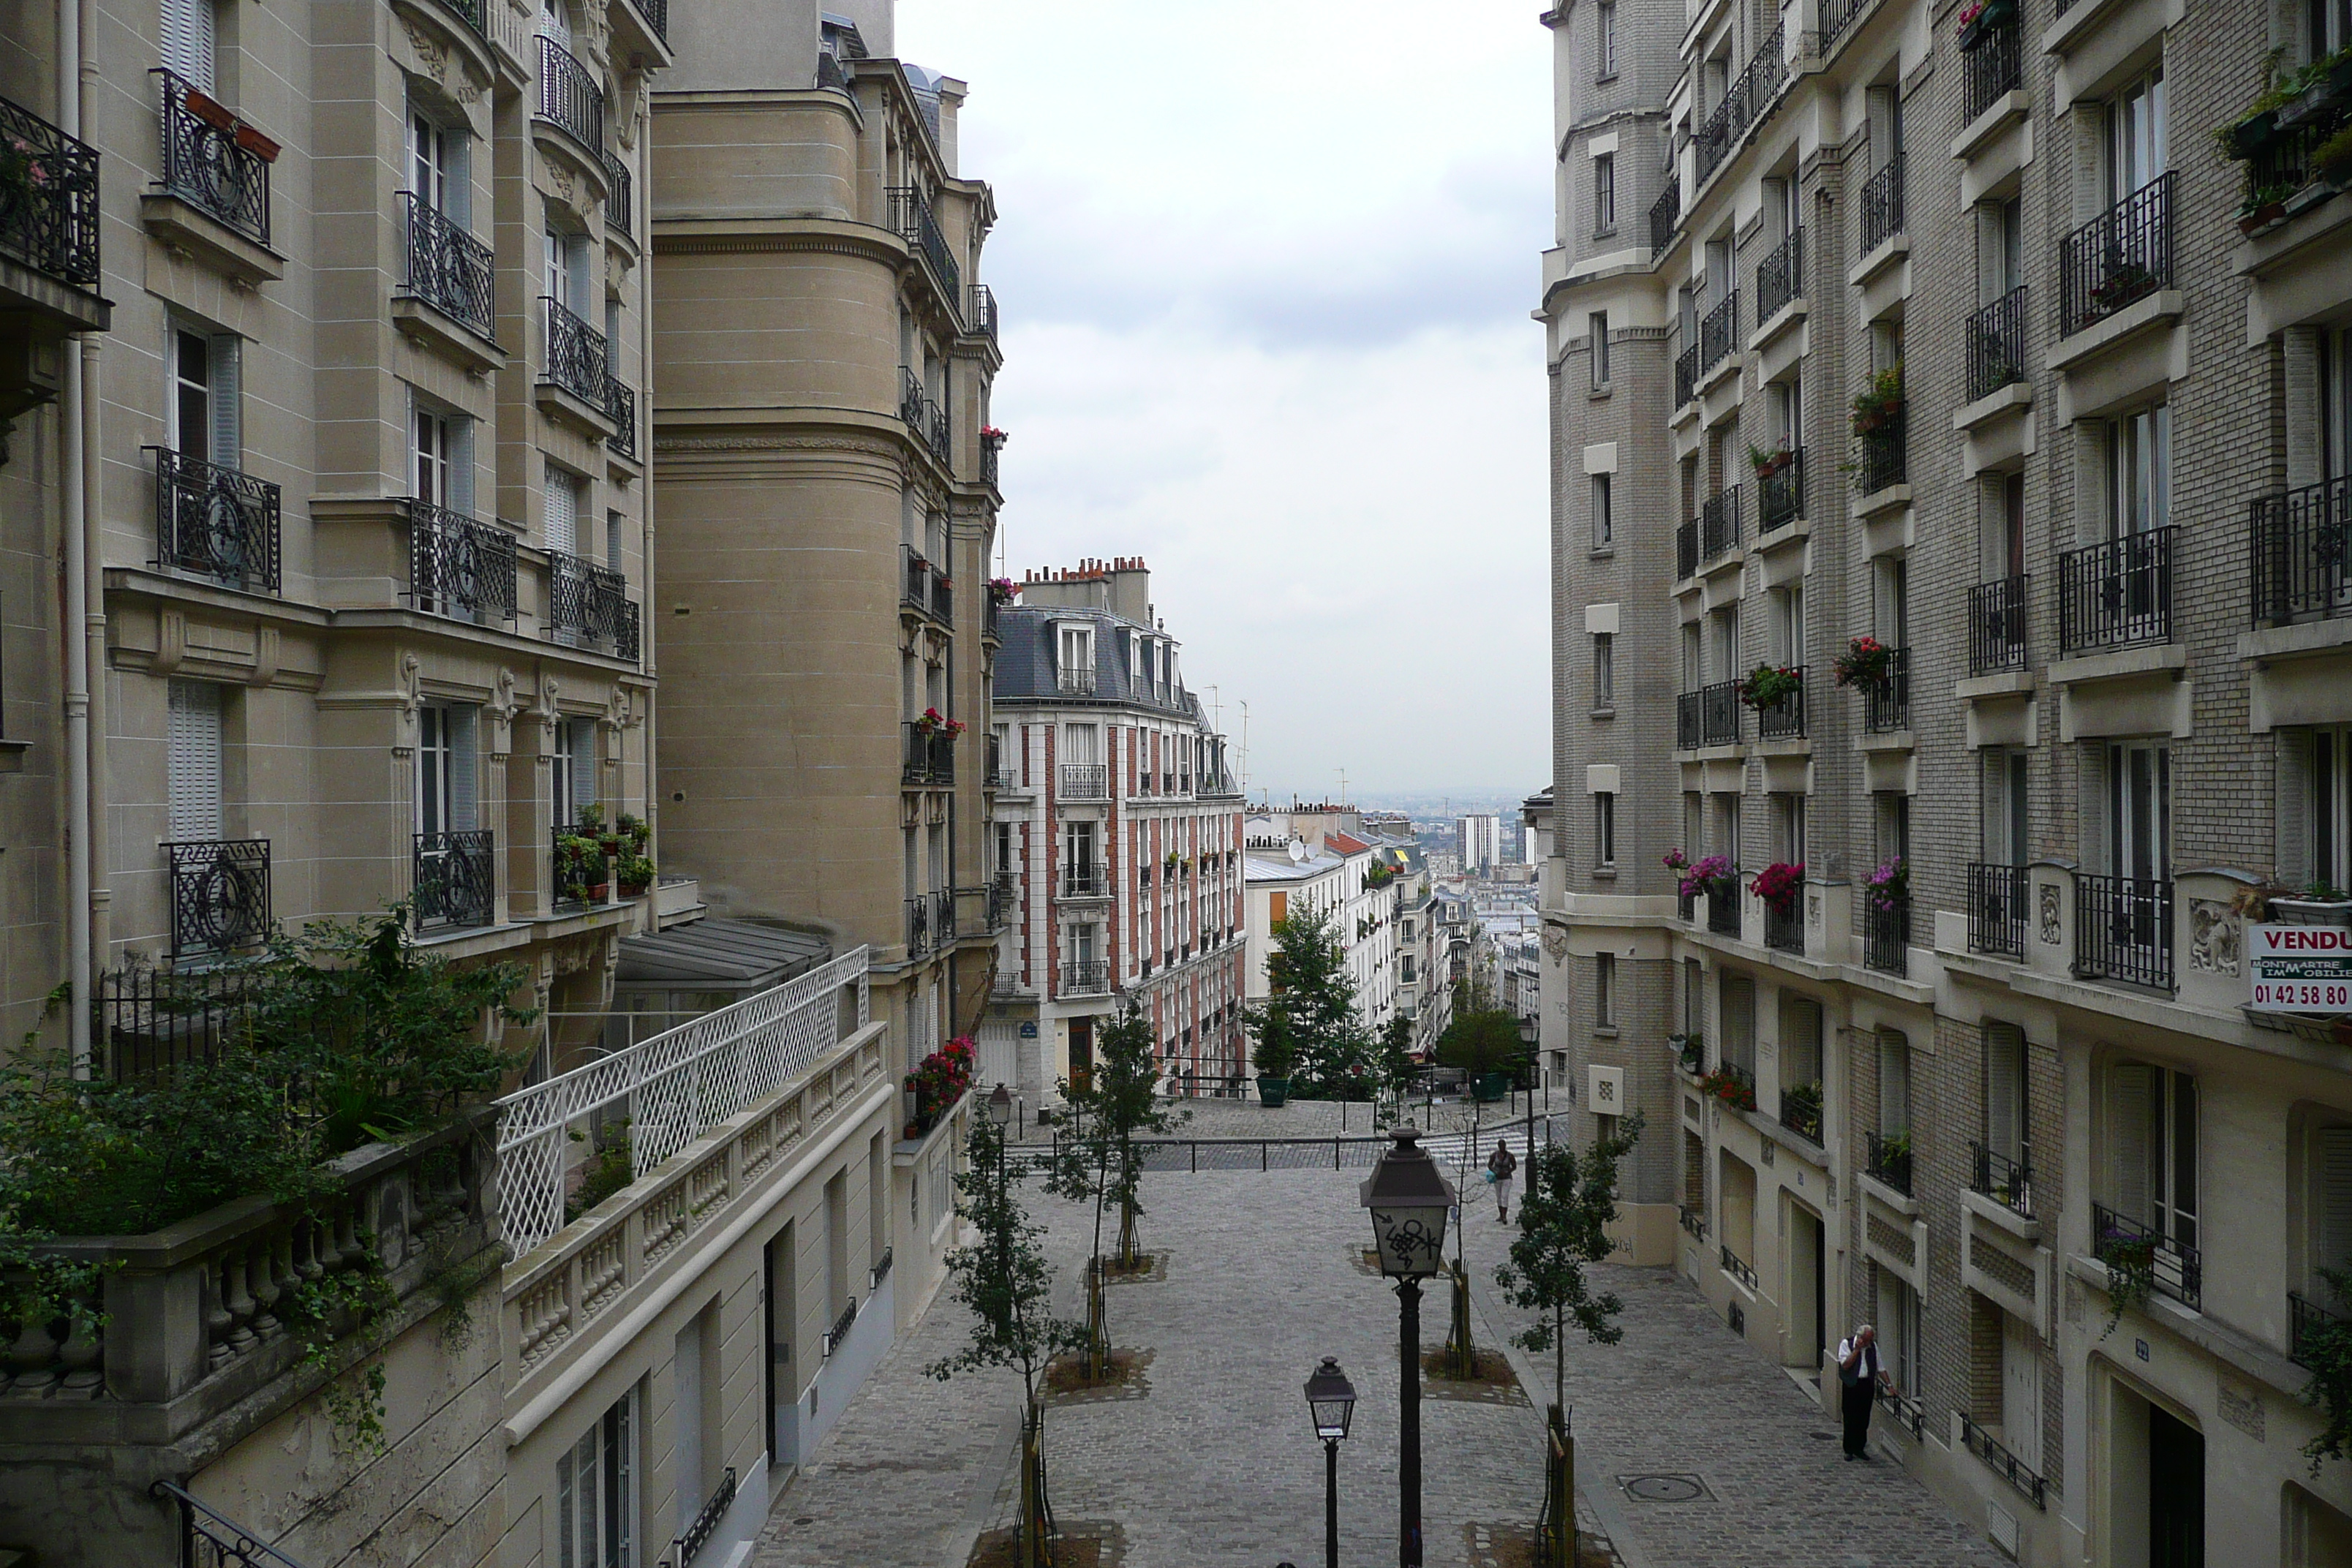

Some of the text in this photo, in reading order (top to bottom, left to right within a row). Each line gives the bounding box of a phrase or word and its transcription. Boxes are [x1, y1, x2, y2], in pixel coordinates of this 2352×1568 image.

[2264, 931, 2352, 949] VENDU
[2255, 985, 2347, 1006] 01 42 58 80
